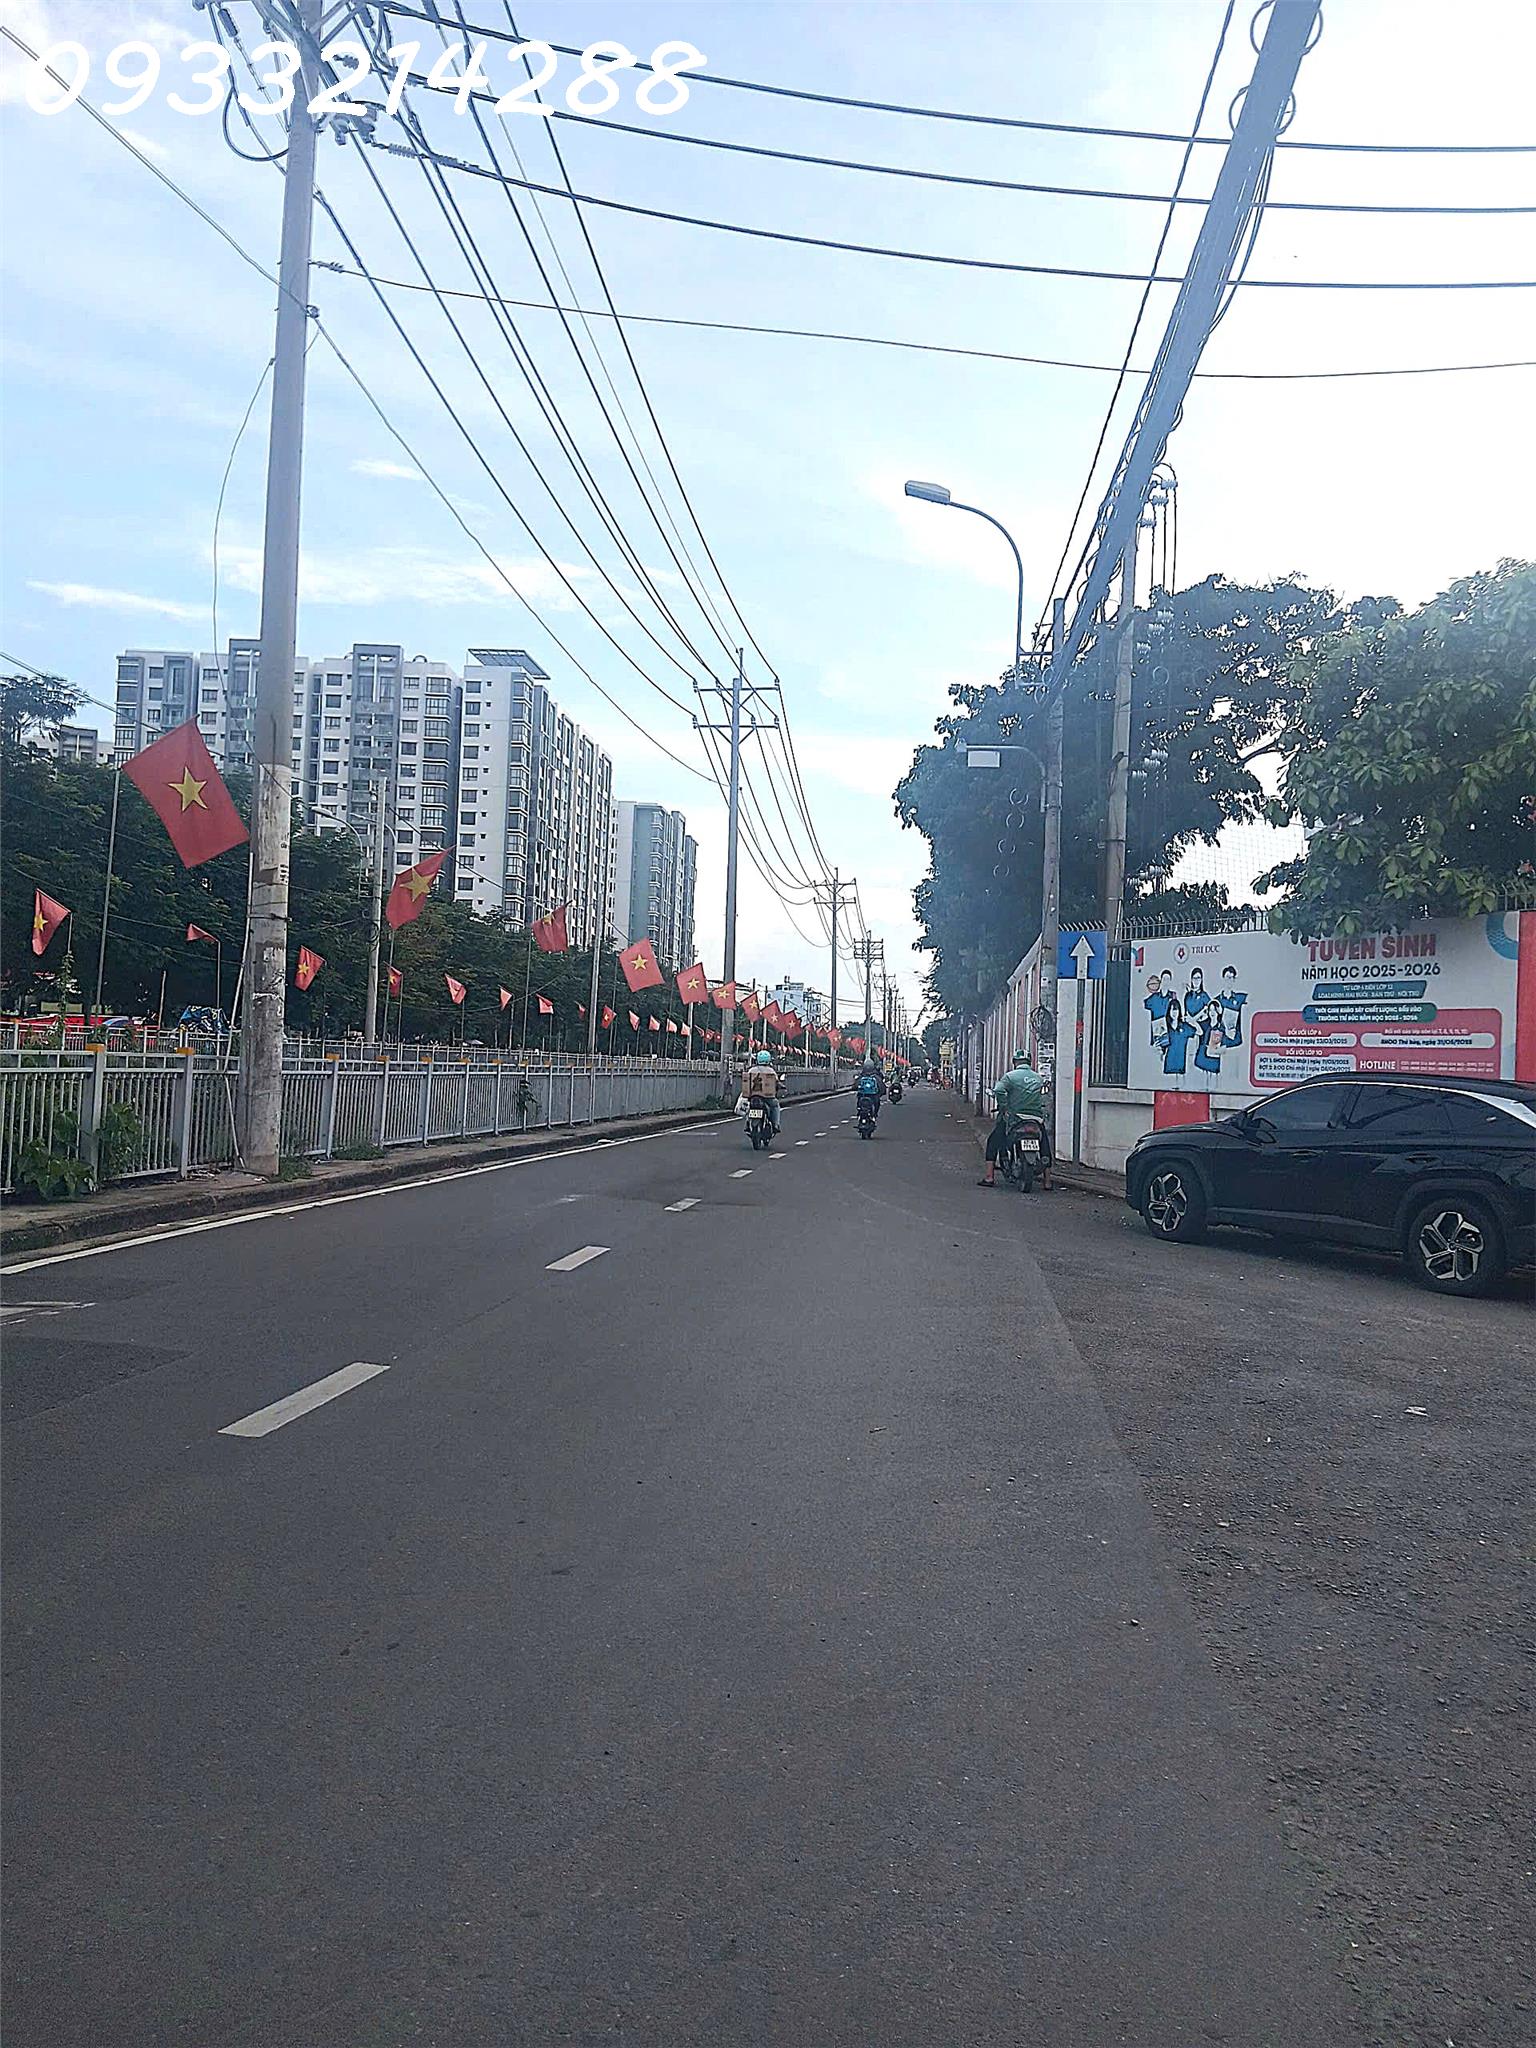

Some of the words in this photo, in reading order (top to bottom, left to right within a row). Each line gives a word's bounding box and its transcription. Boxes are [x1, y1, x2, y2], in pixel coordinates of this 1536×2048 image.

[1382, 934, 1437, 958] SINH
[1301, 965, 1327, 980] NĂM
[1331, 966, 1359, 981] HỌC
[1360, 1060, 1396, 1070] HOTLINE
